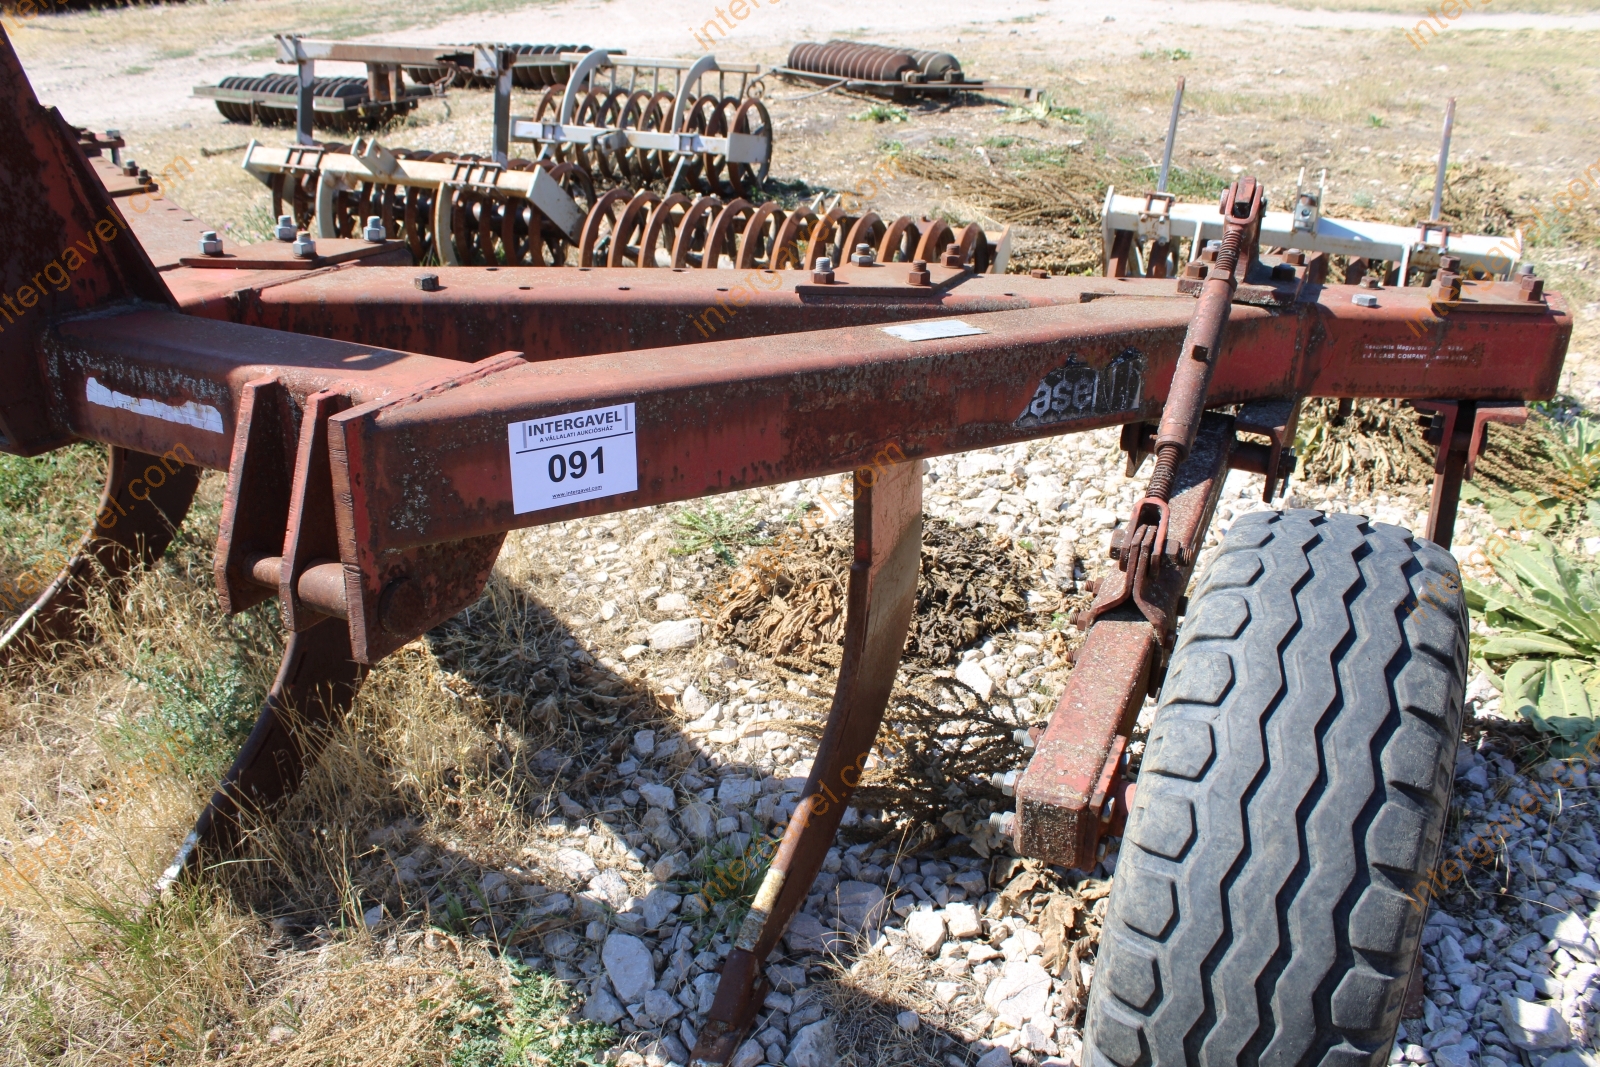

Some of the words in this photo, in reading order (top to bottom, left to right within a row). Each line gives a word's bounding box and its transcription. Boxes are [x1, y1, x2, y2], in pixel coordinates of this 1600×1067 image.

[528, 411, 622, 437] INTERGAVEL
[545, 432, 576, 442] VÁLLALATI
[548, 446, 604, 483] 091
[552, 485, 603, 500] www.intergavel.com
